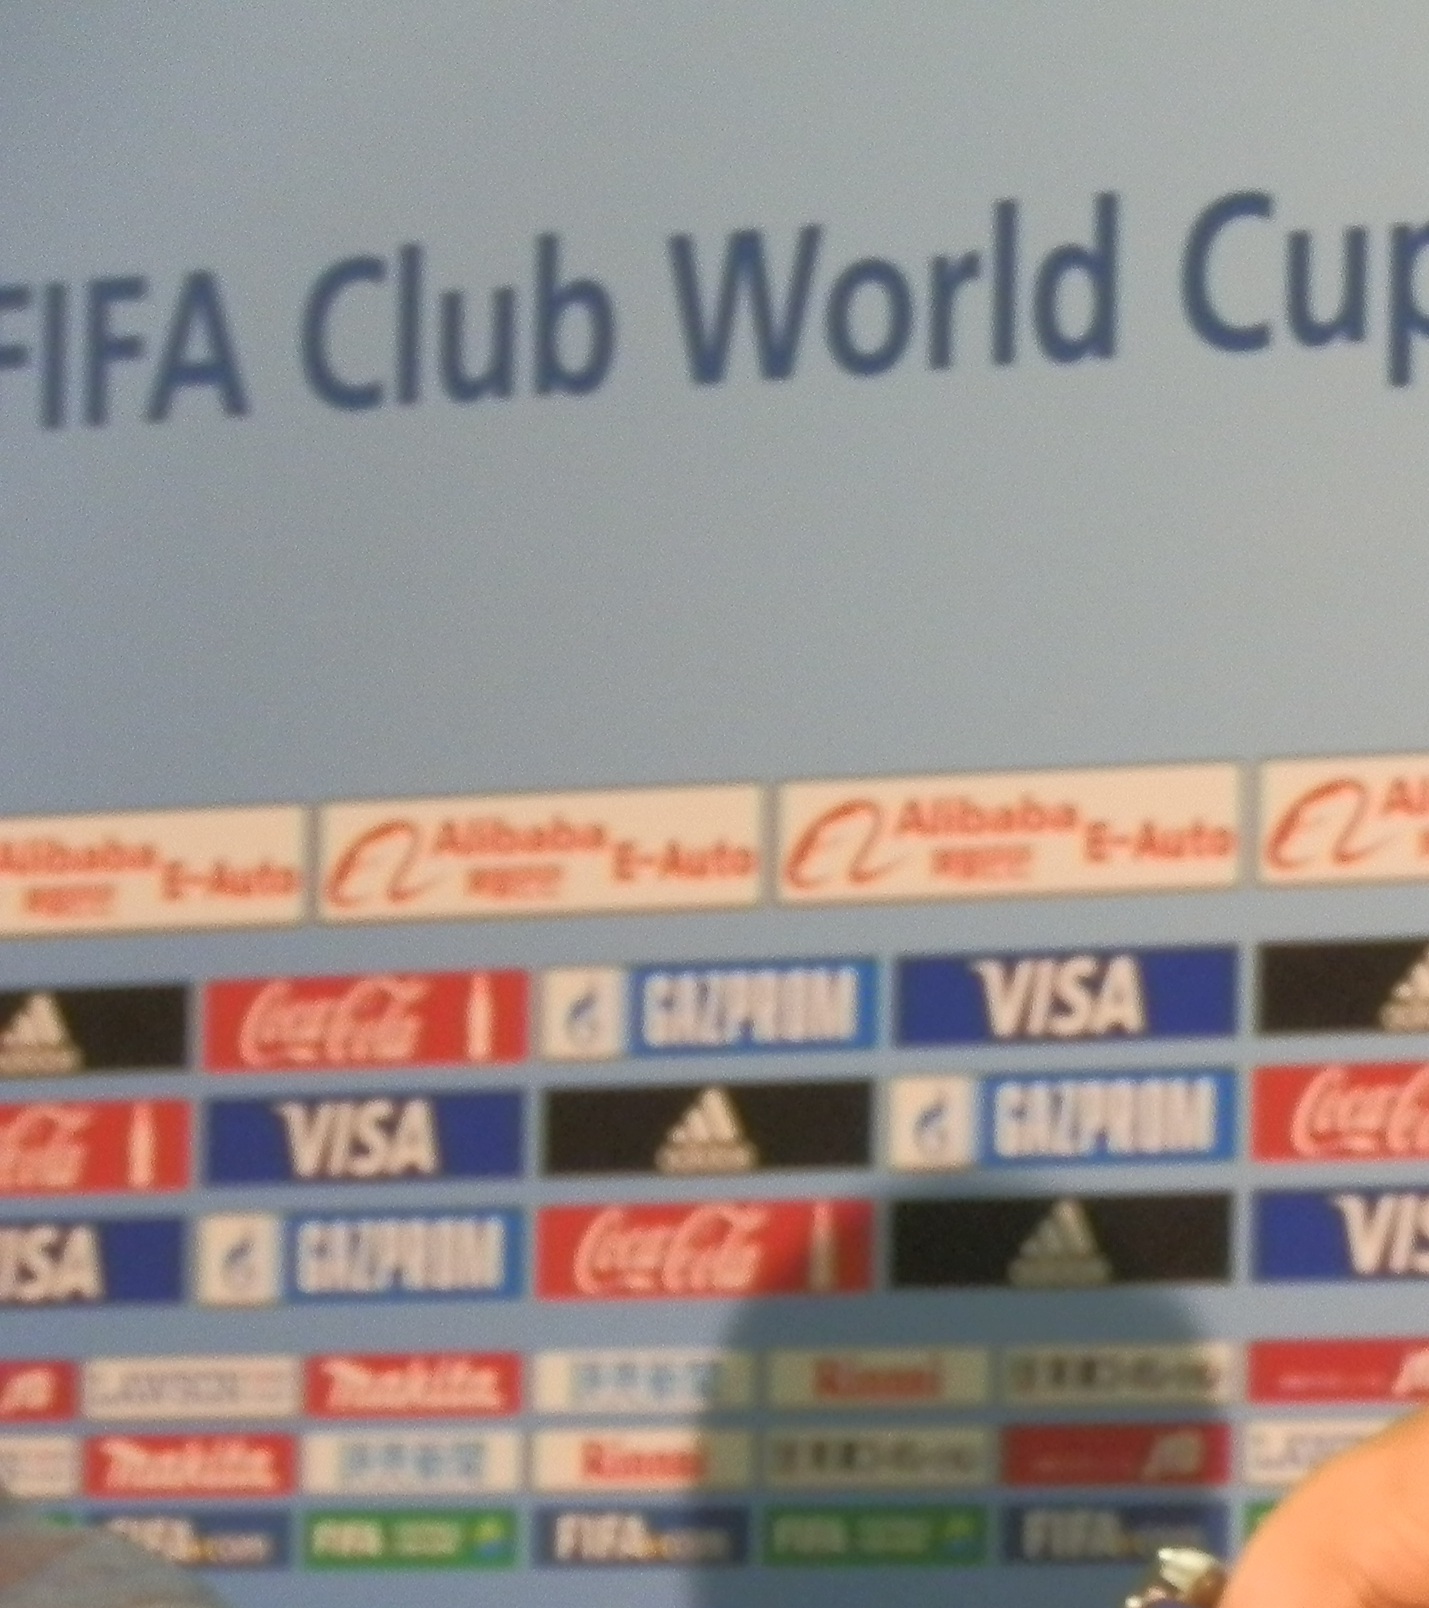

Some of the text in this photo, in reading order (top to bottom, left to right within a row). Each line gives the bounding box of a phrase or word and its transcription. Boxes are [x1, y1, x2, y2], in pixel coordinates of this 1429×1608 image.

[300, 232, 617, 411] Club
[666, 190, 1120, 386] World
[894, 793, 1081, 838] Alibaba
[1083, 817, 1237, 866] E-Auto
[641, 966, 859, 1048] GAZPROM
[972, 955, 1147, 1038] VISA
[273, 1099, 442, 1177] VISA
[995, 1077, 1218, 1157] GAZPROM
[296, 1217, 506, 1294] GAZPROM
